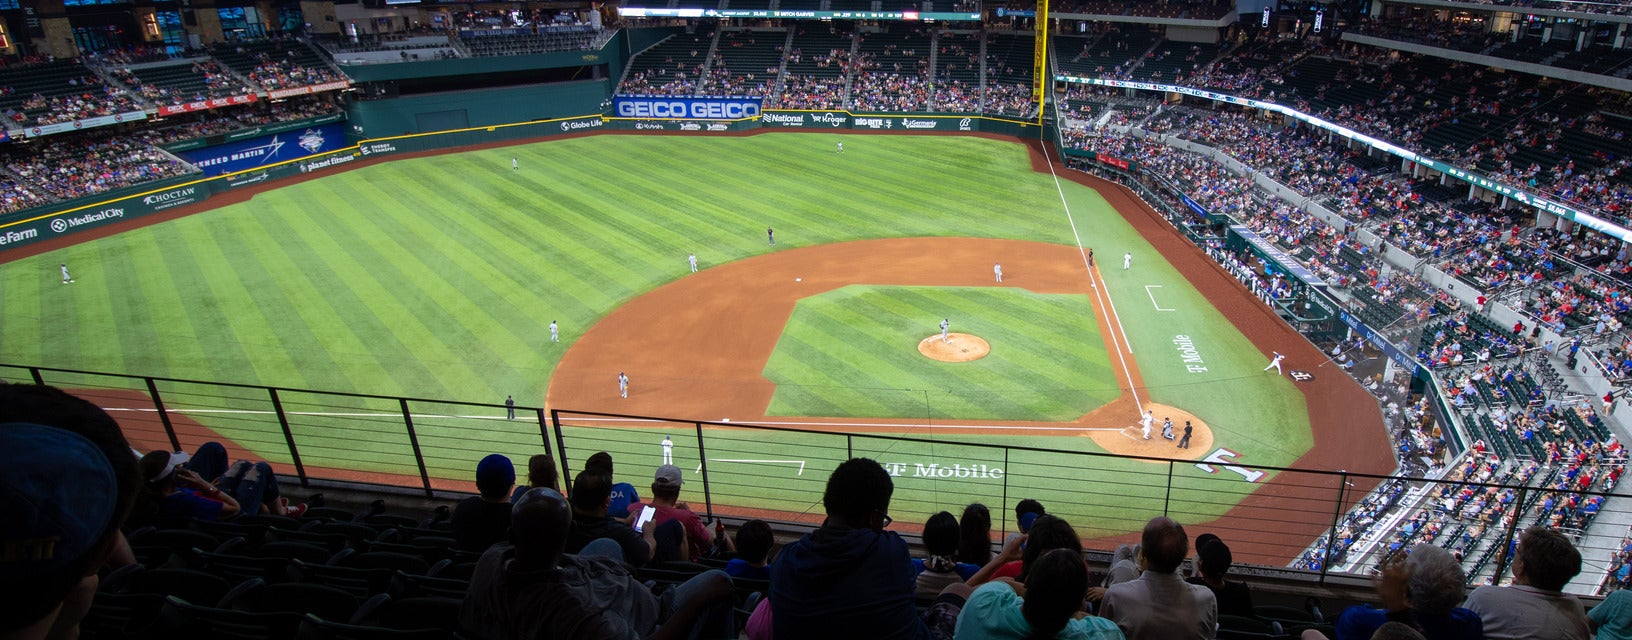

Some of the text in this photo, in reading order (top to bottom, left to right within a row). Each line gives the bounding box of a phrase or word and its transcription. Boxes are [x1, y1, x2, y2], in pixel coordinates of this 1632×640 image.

[618, 101, 687, 118] GEICO
[691, 102, 760, 119] GEICO
[570, 120, 603, 130] Globe Life
[772, 114, 804, 123] National
[822, 112, 846, 127] Kroger
[231, 149, 265, 161] MARTIN
[307, 153, 354, 172] planet fitness
[68, 207, 125, 228] Medical City
[1172, 334, 1204, 364] Mobile
[914, 463, 1004, 479] Mobile
